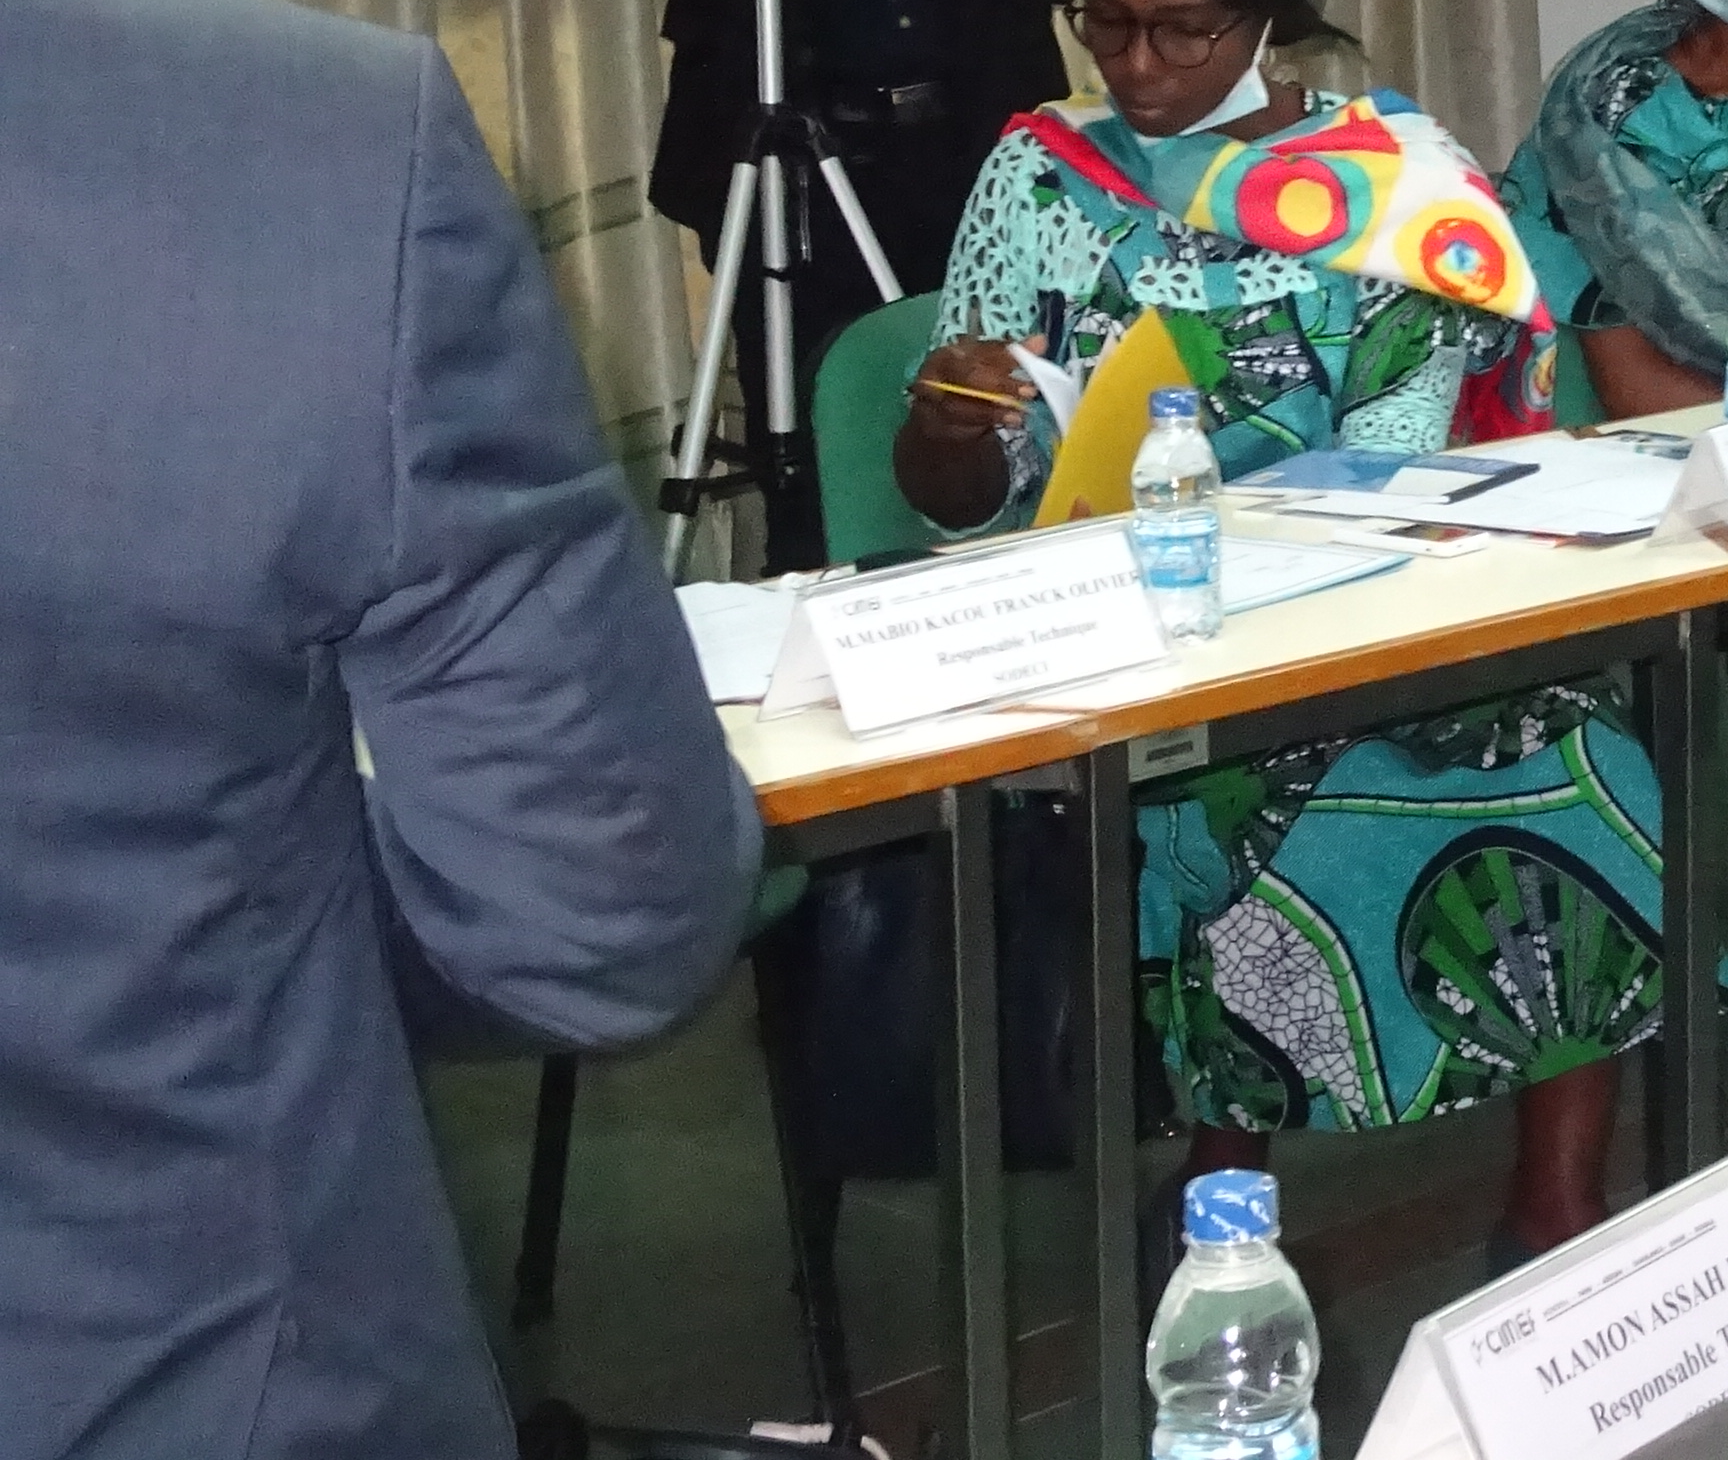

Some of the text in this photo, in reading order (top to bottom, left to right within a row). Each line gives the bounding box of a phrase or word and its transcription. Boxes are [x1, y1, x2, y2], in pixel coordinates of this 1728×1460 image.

[993, 586, 1066, 616] FRANCK
[936, 620, 1098, 666] Responsable Technique
[1534, 1309, 1650, 1394] M.AMON
[1649, 1264, 1726, 1332] ASSAH
[1586, 1338, 1719, 1435] Responsable
